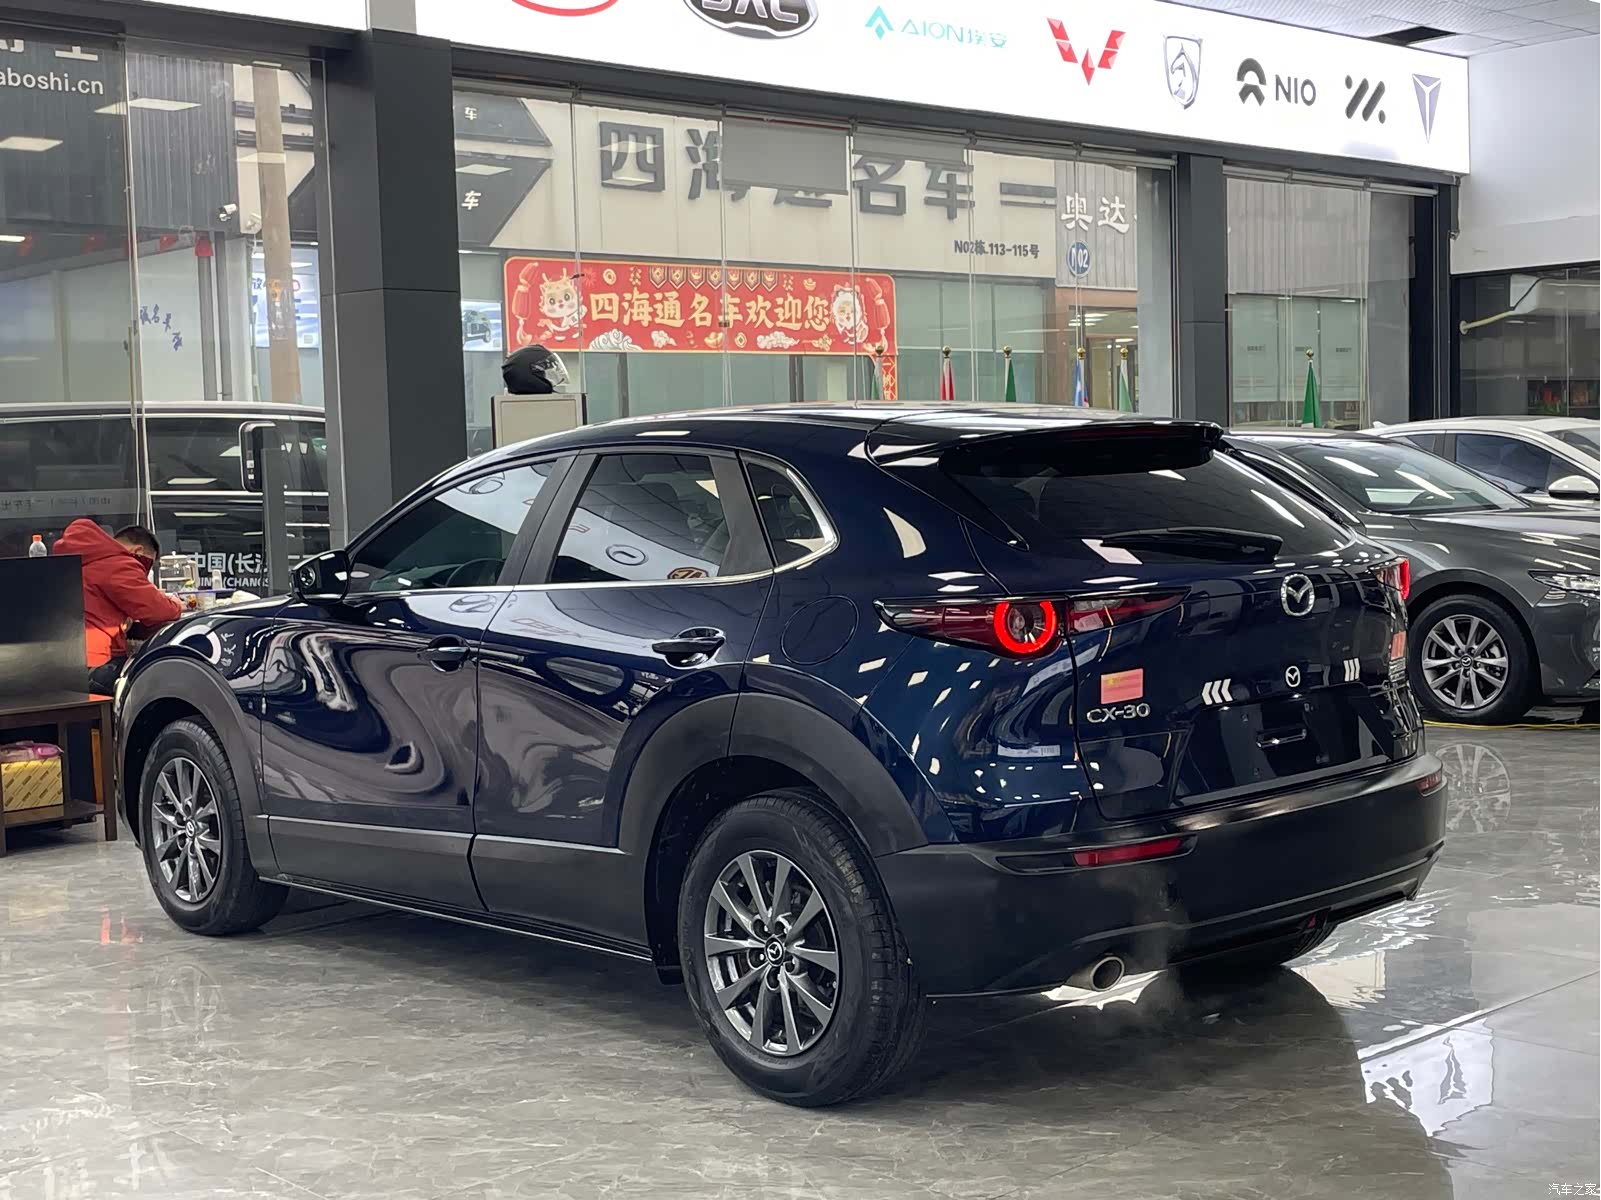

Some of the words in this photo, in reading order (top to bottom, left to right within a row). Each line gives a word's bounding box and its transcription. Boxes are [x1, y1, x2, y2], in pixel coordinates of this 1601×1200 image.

[1275, 74, 1316, 106] NIO
[461, 190, 481, 210] 车
[1061, 193, 1138, 234] 奥达
[589, 287, 830, 331] 四海通名车欢迎您
[1087, 703, 1150, 723] CX-30
